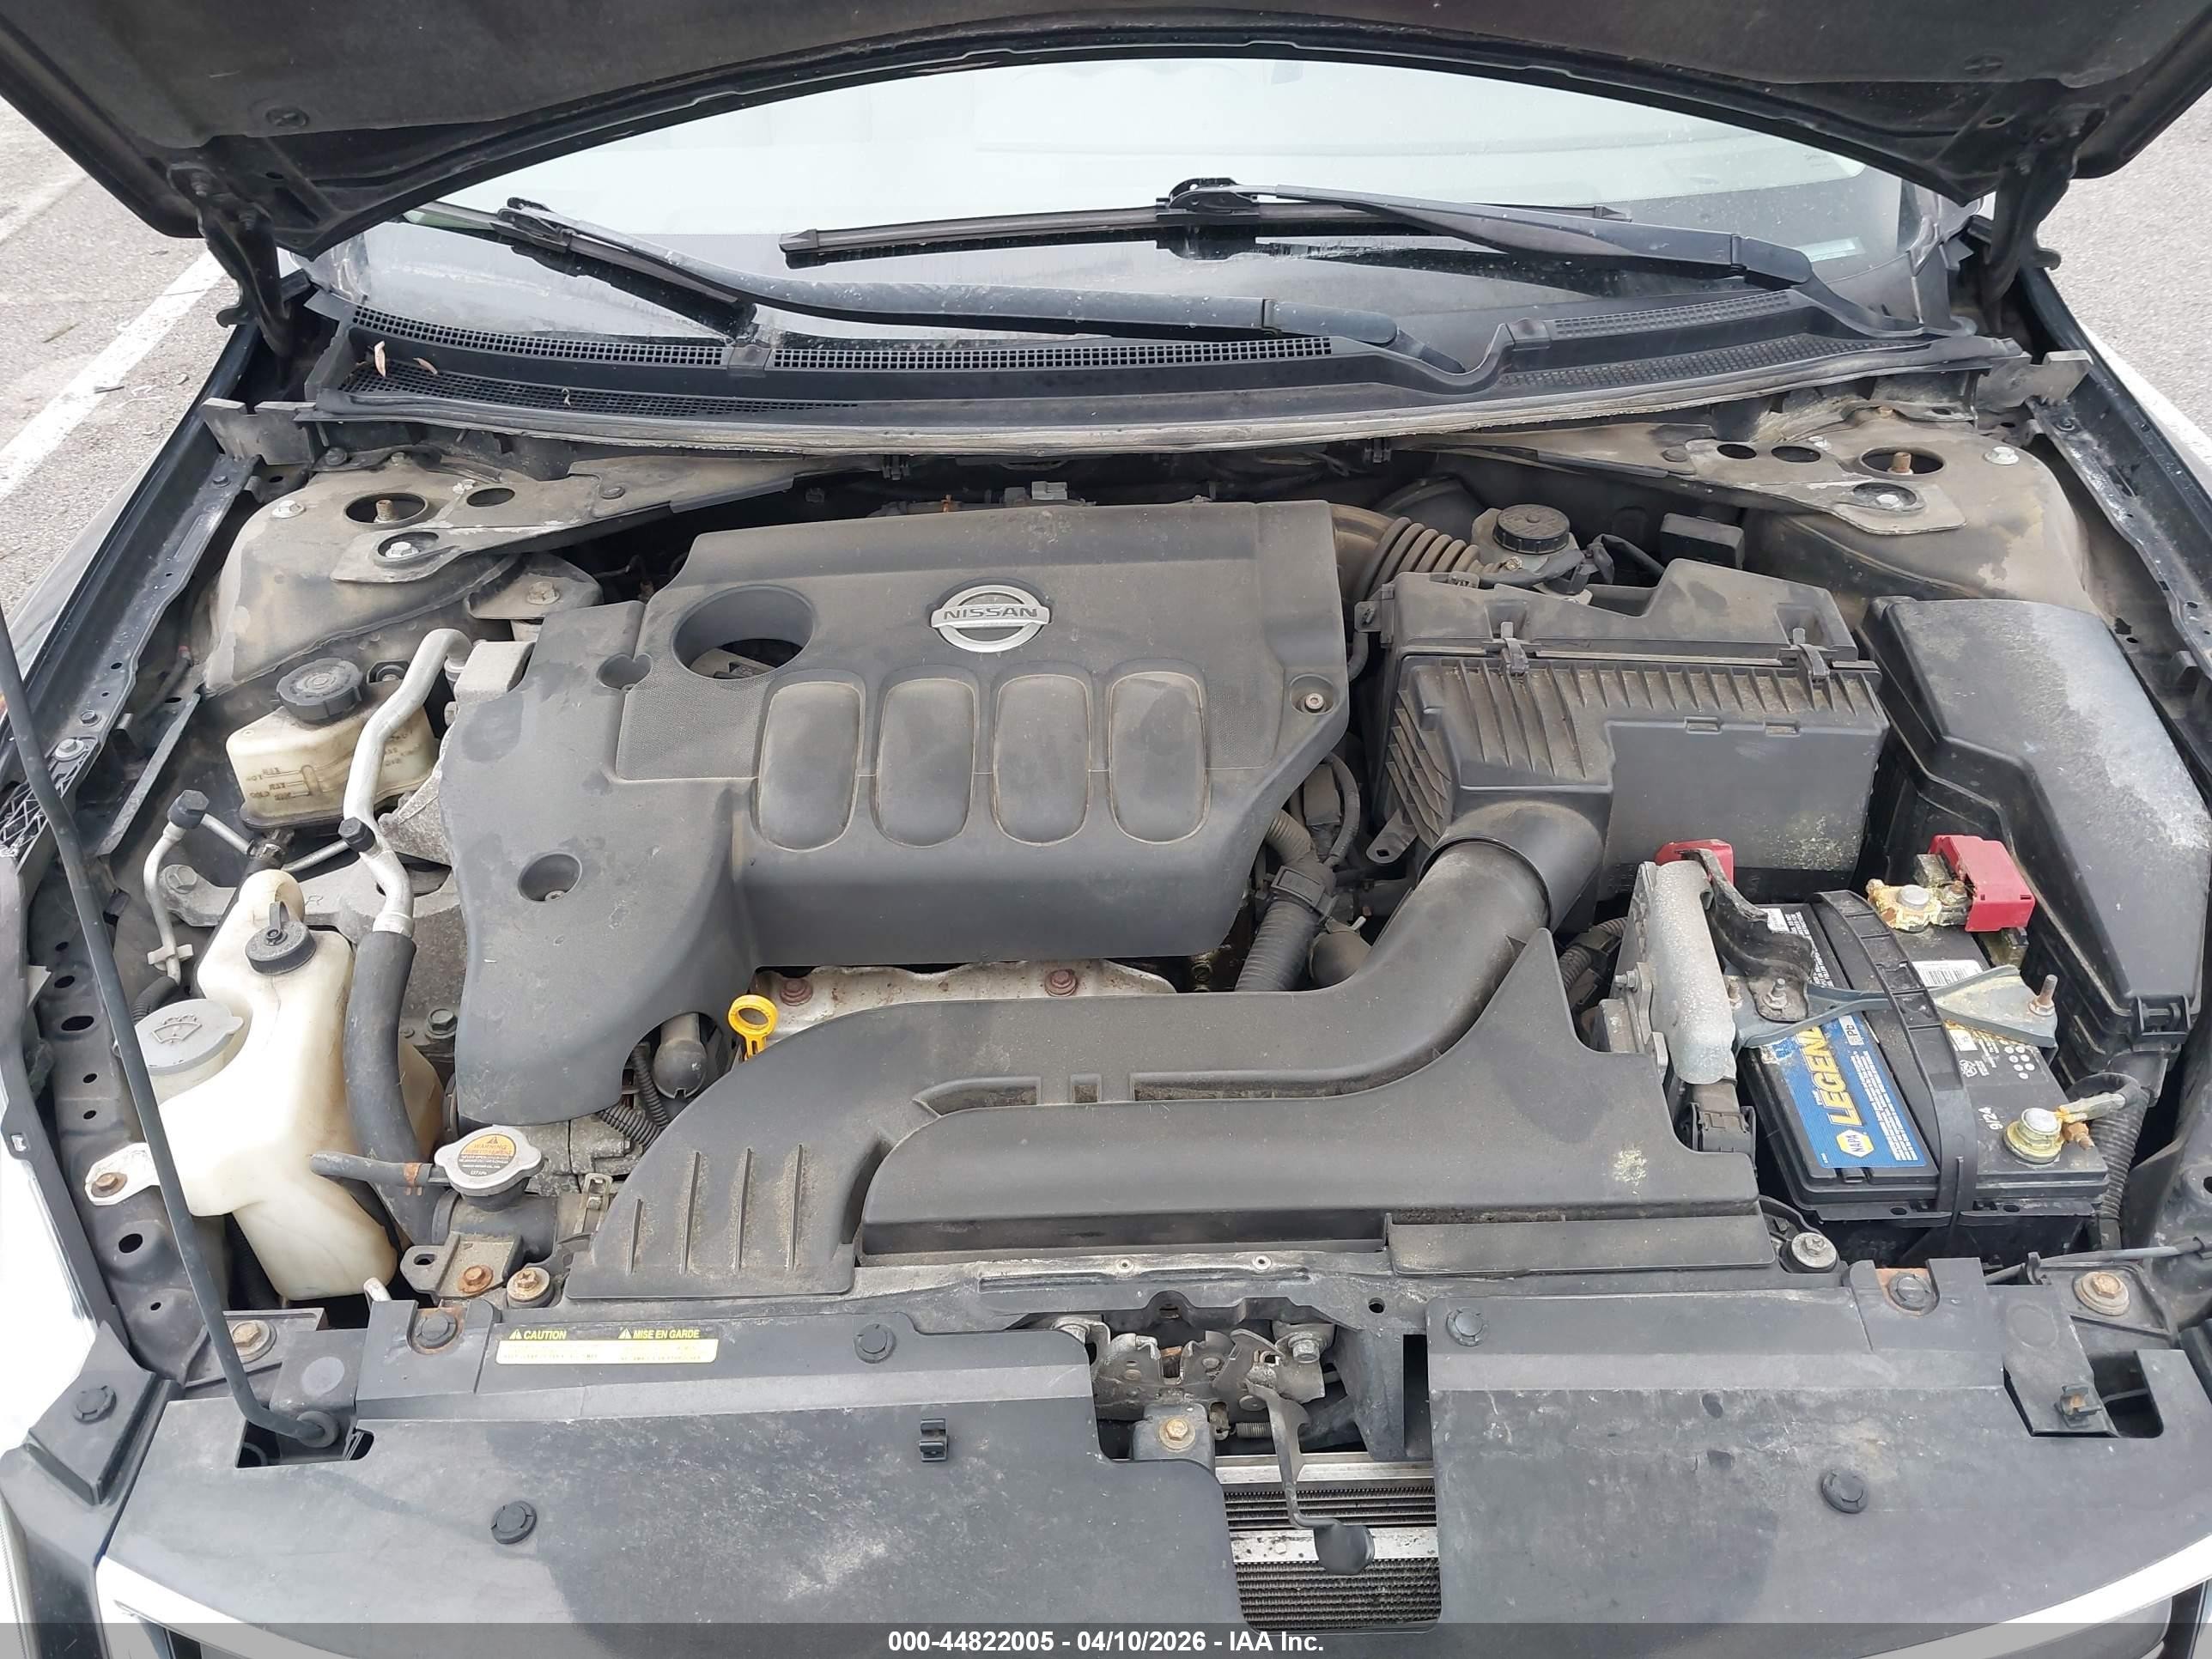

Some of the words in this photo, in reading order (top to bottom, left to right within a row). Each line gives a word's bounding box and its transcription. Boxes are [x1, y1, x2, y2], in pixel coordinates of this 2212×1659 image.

[944, 607, 1037, 620] NISSAN
[1848, 1024, 1858, 1037] Pb
[1978, 1106, 2004, 1130] 9/24
[1849, 1133, 1865, 1153] NAPA
[523, 1330, 567, 1340] CAUTION
[633, 1329, 653, 1340] MISE
[655, 1329, 668, 1339] EN
[669, 1329, 700, 1339] GARDE
